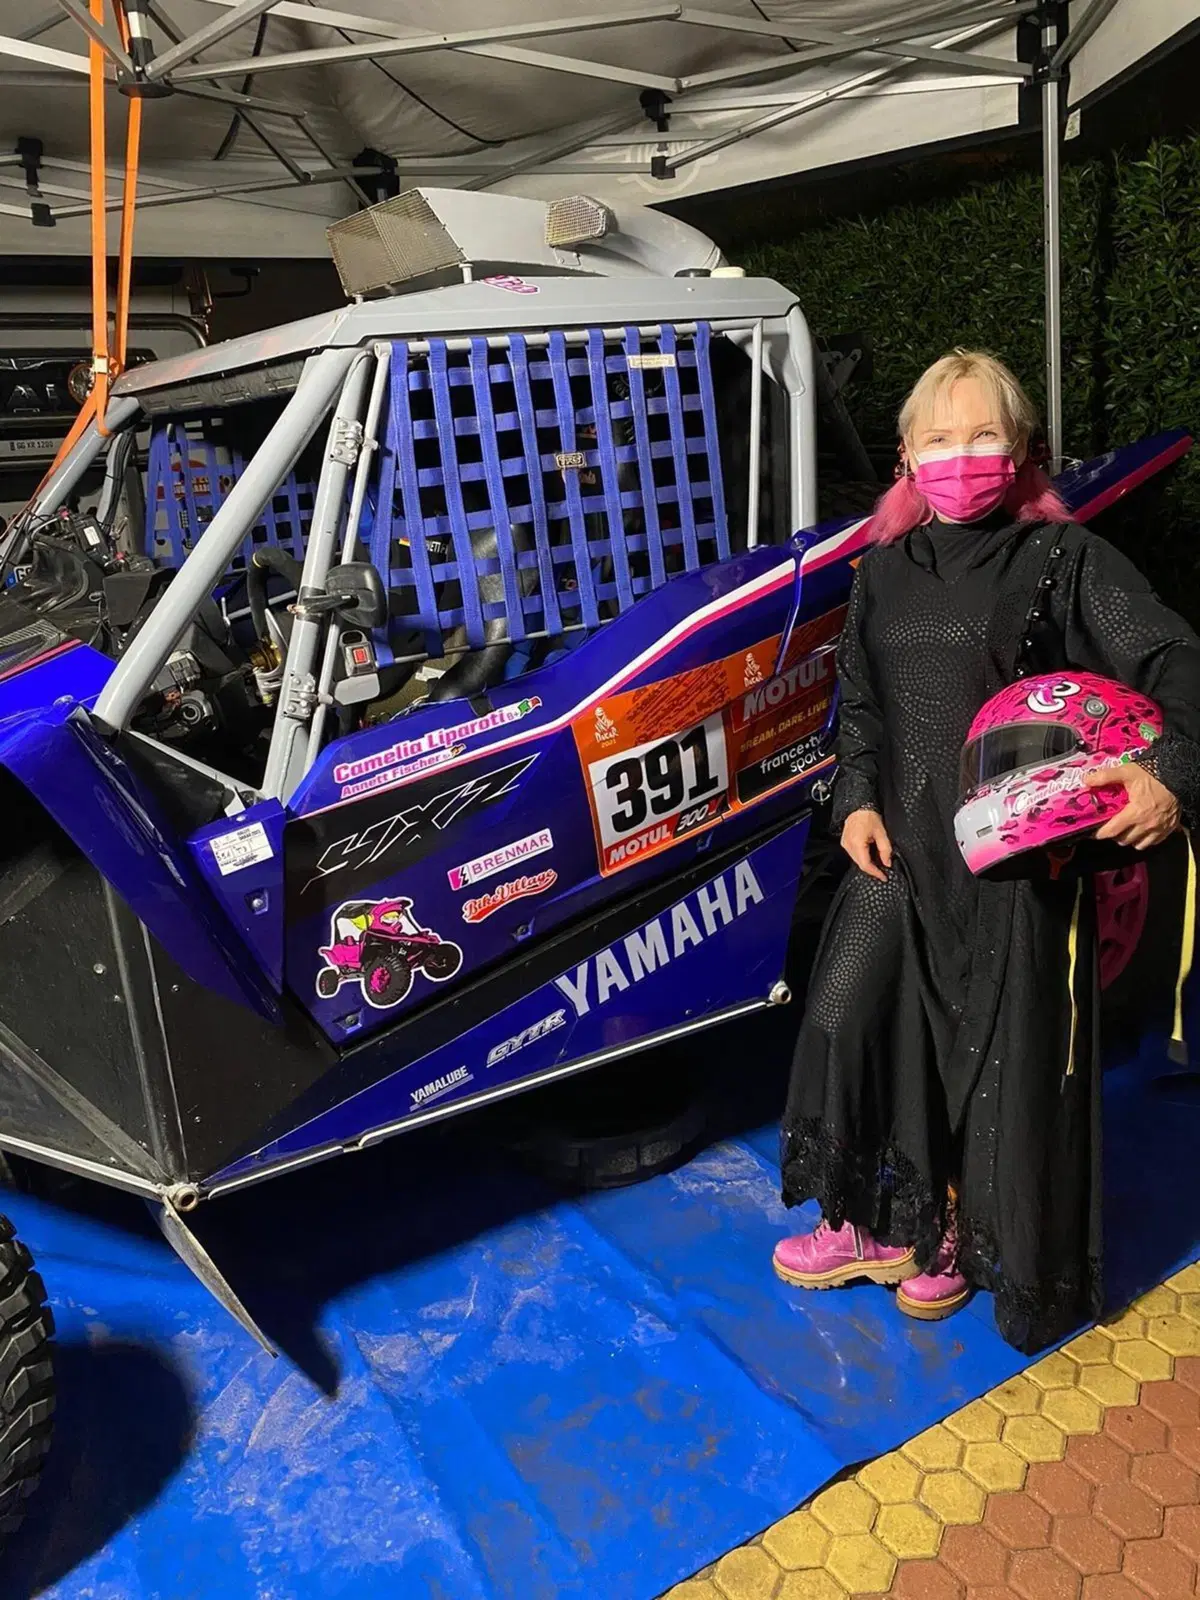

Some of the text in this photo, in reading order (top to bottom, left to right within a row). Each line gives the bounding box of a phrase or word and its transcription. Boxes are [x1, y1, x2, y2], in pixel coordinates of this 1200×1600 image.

[743, 655, 829, 722] MOTUL
[334, 741, 422, 783] Camelia
[427, 709, 506, 748] Liparoti
[789, 746, 825, 773] sport
[342, 753, 441, 798] Annett Fischer
[605, 724, 719, 833] 391
[471, 833, 550, 876] BRENMAR
[608, 824, 671, 866] MOTUL
[554, 859, 765, 1018] YAMAHA
[486, 1008, 566, 1066] GYTR
[410, 1065, 469, 1103] YAMALUBE
